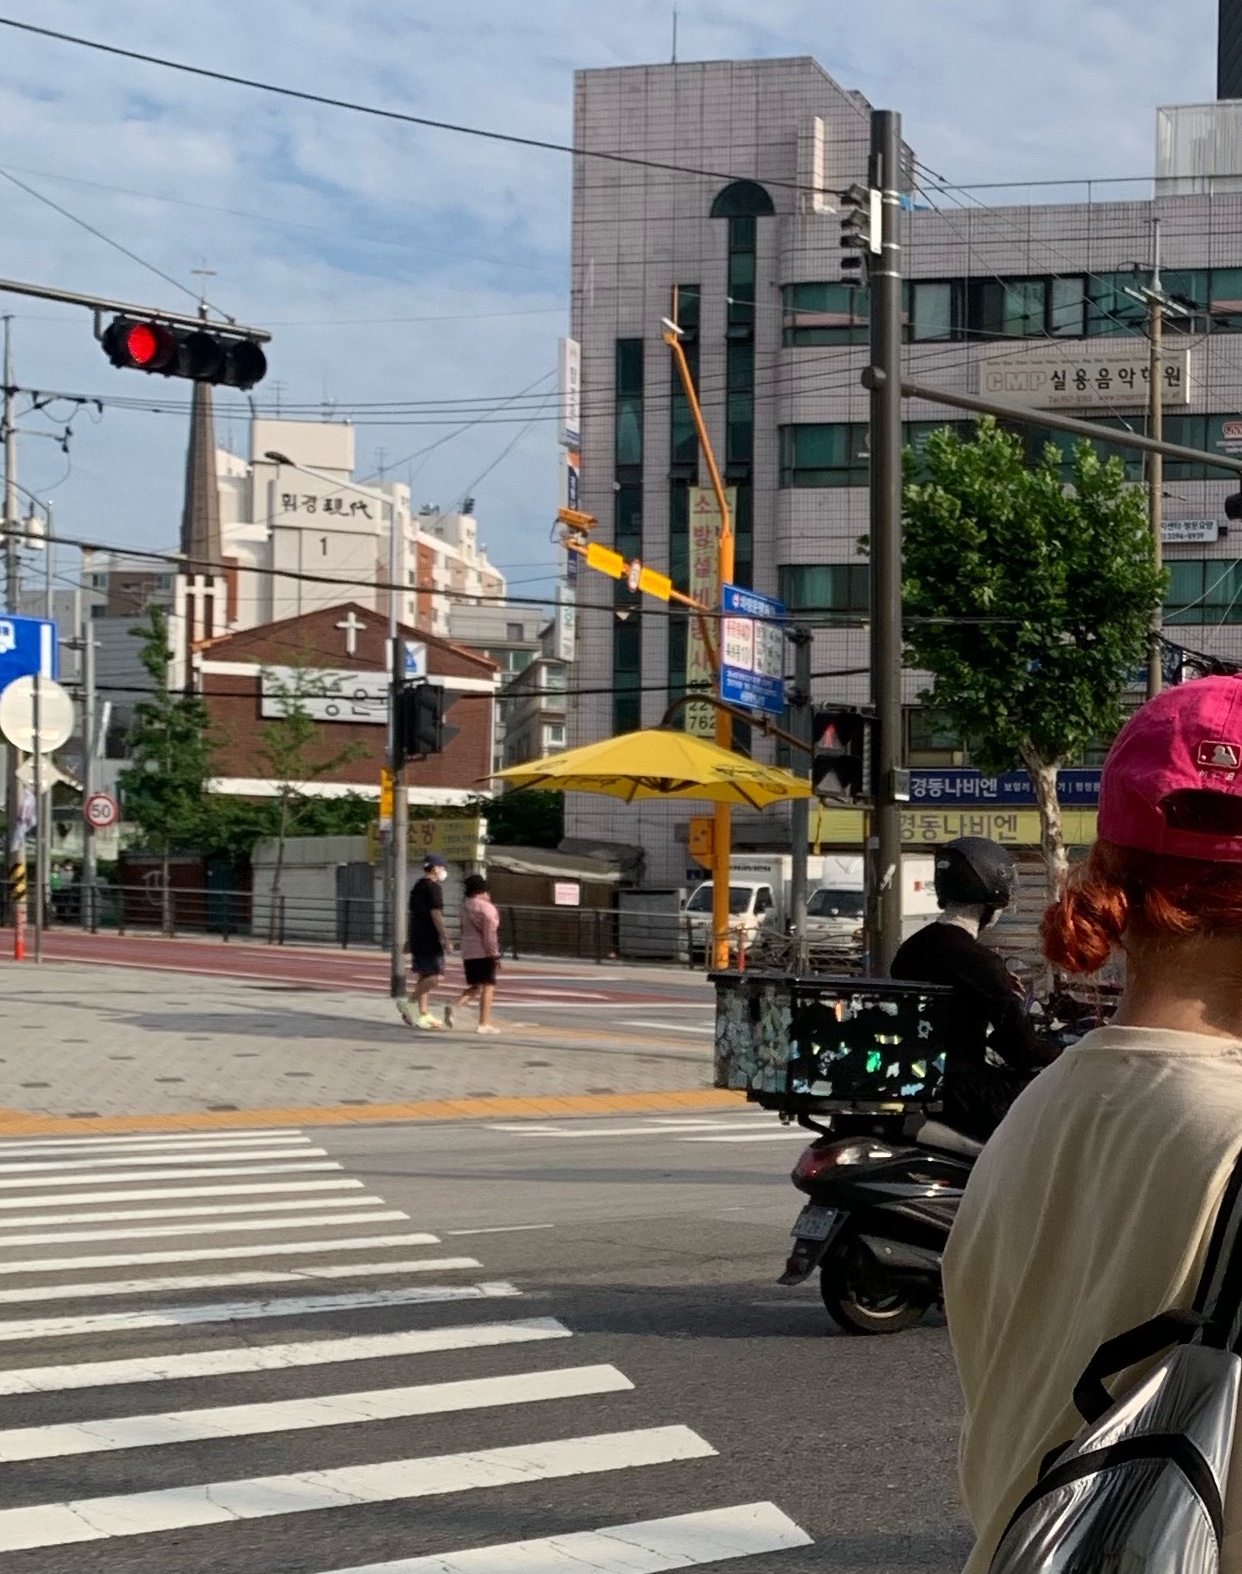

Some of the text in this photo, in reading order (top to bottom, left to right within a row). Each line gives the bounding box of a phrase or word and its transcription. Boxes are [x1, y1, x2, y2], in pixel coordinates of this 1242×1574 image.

[986, 371, 1047, 393] CMP
[320, 536, 327, 556] 1
[911, 778, 998, 797] 경동나비엔
[92, 804, 110, 817] 50
